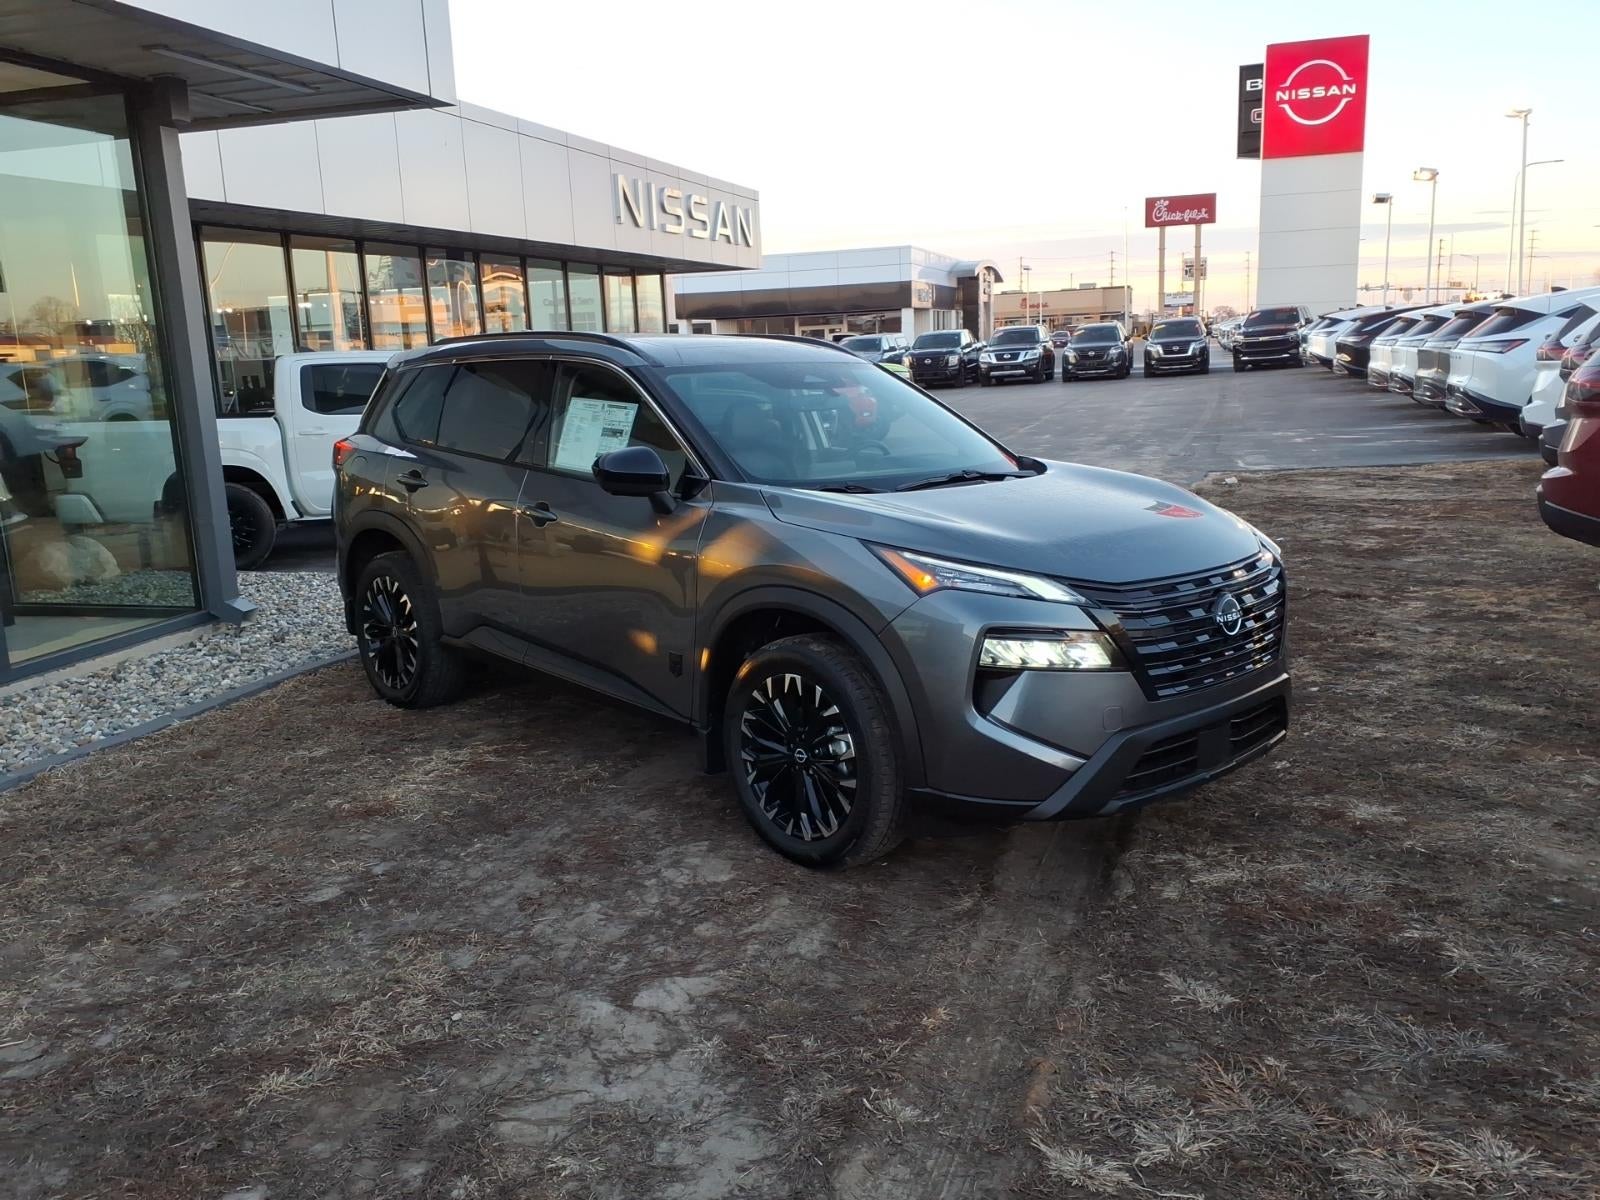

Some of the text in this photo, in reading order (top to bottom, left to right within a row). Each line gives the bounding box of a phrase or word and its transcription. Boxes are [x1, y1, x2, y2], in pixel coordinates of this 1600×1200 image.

[1276, 83, 1356, 101] NISSAN
[614, 174, 753, 247] NISSAN
[1216, 611, 1243, 623] NISS
